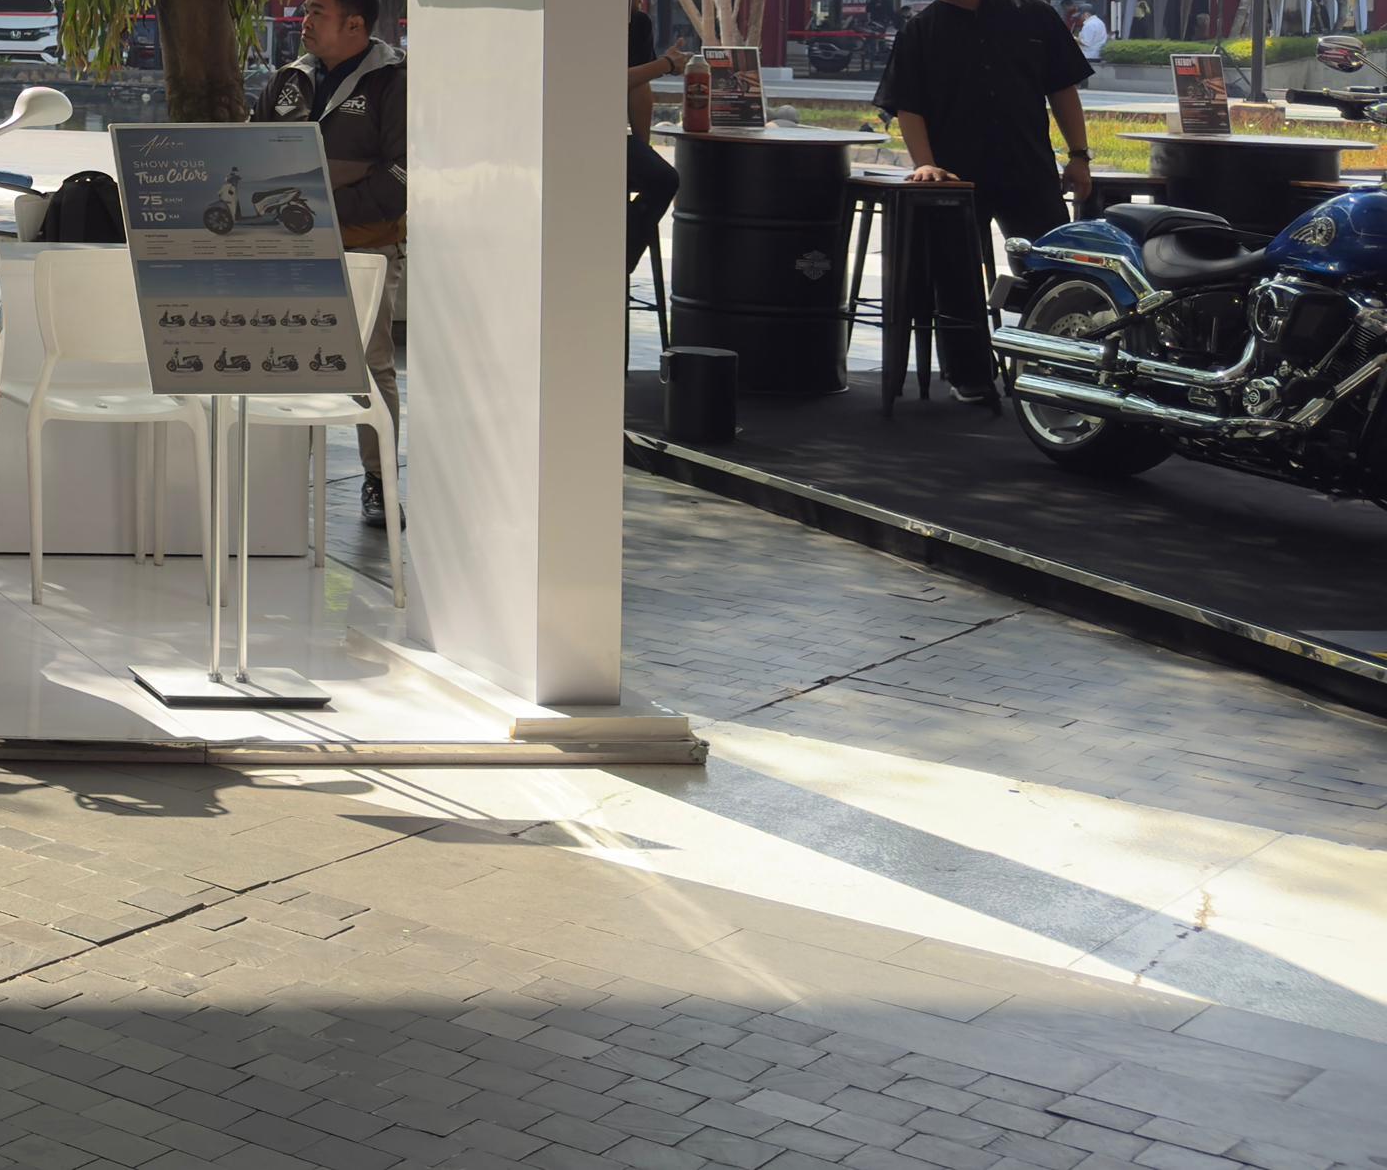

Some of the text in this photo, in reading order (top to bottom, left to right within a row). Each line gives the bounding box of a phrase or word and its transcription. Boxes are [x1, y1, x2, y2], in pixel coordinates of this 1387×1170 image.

[132, 160, 206, 169] SHOW YOUR
[134, 168, 209, 185] True Colors
[138, 195, 163, 206] 75
[141, 211, 167, 222] 110
